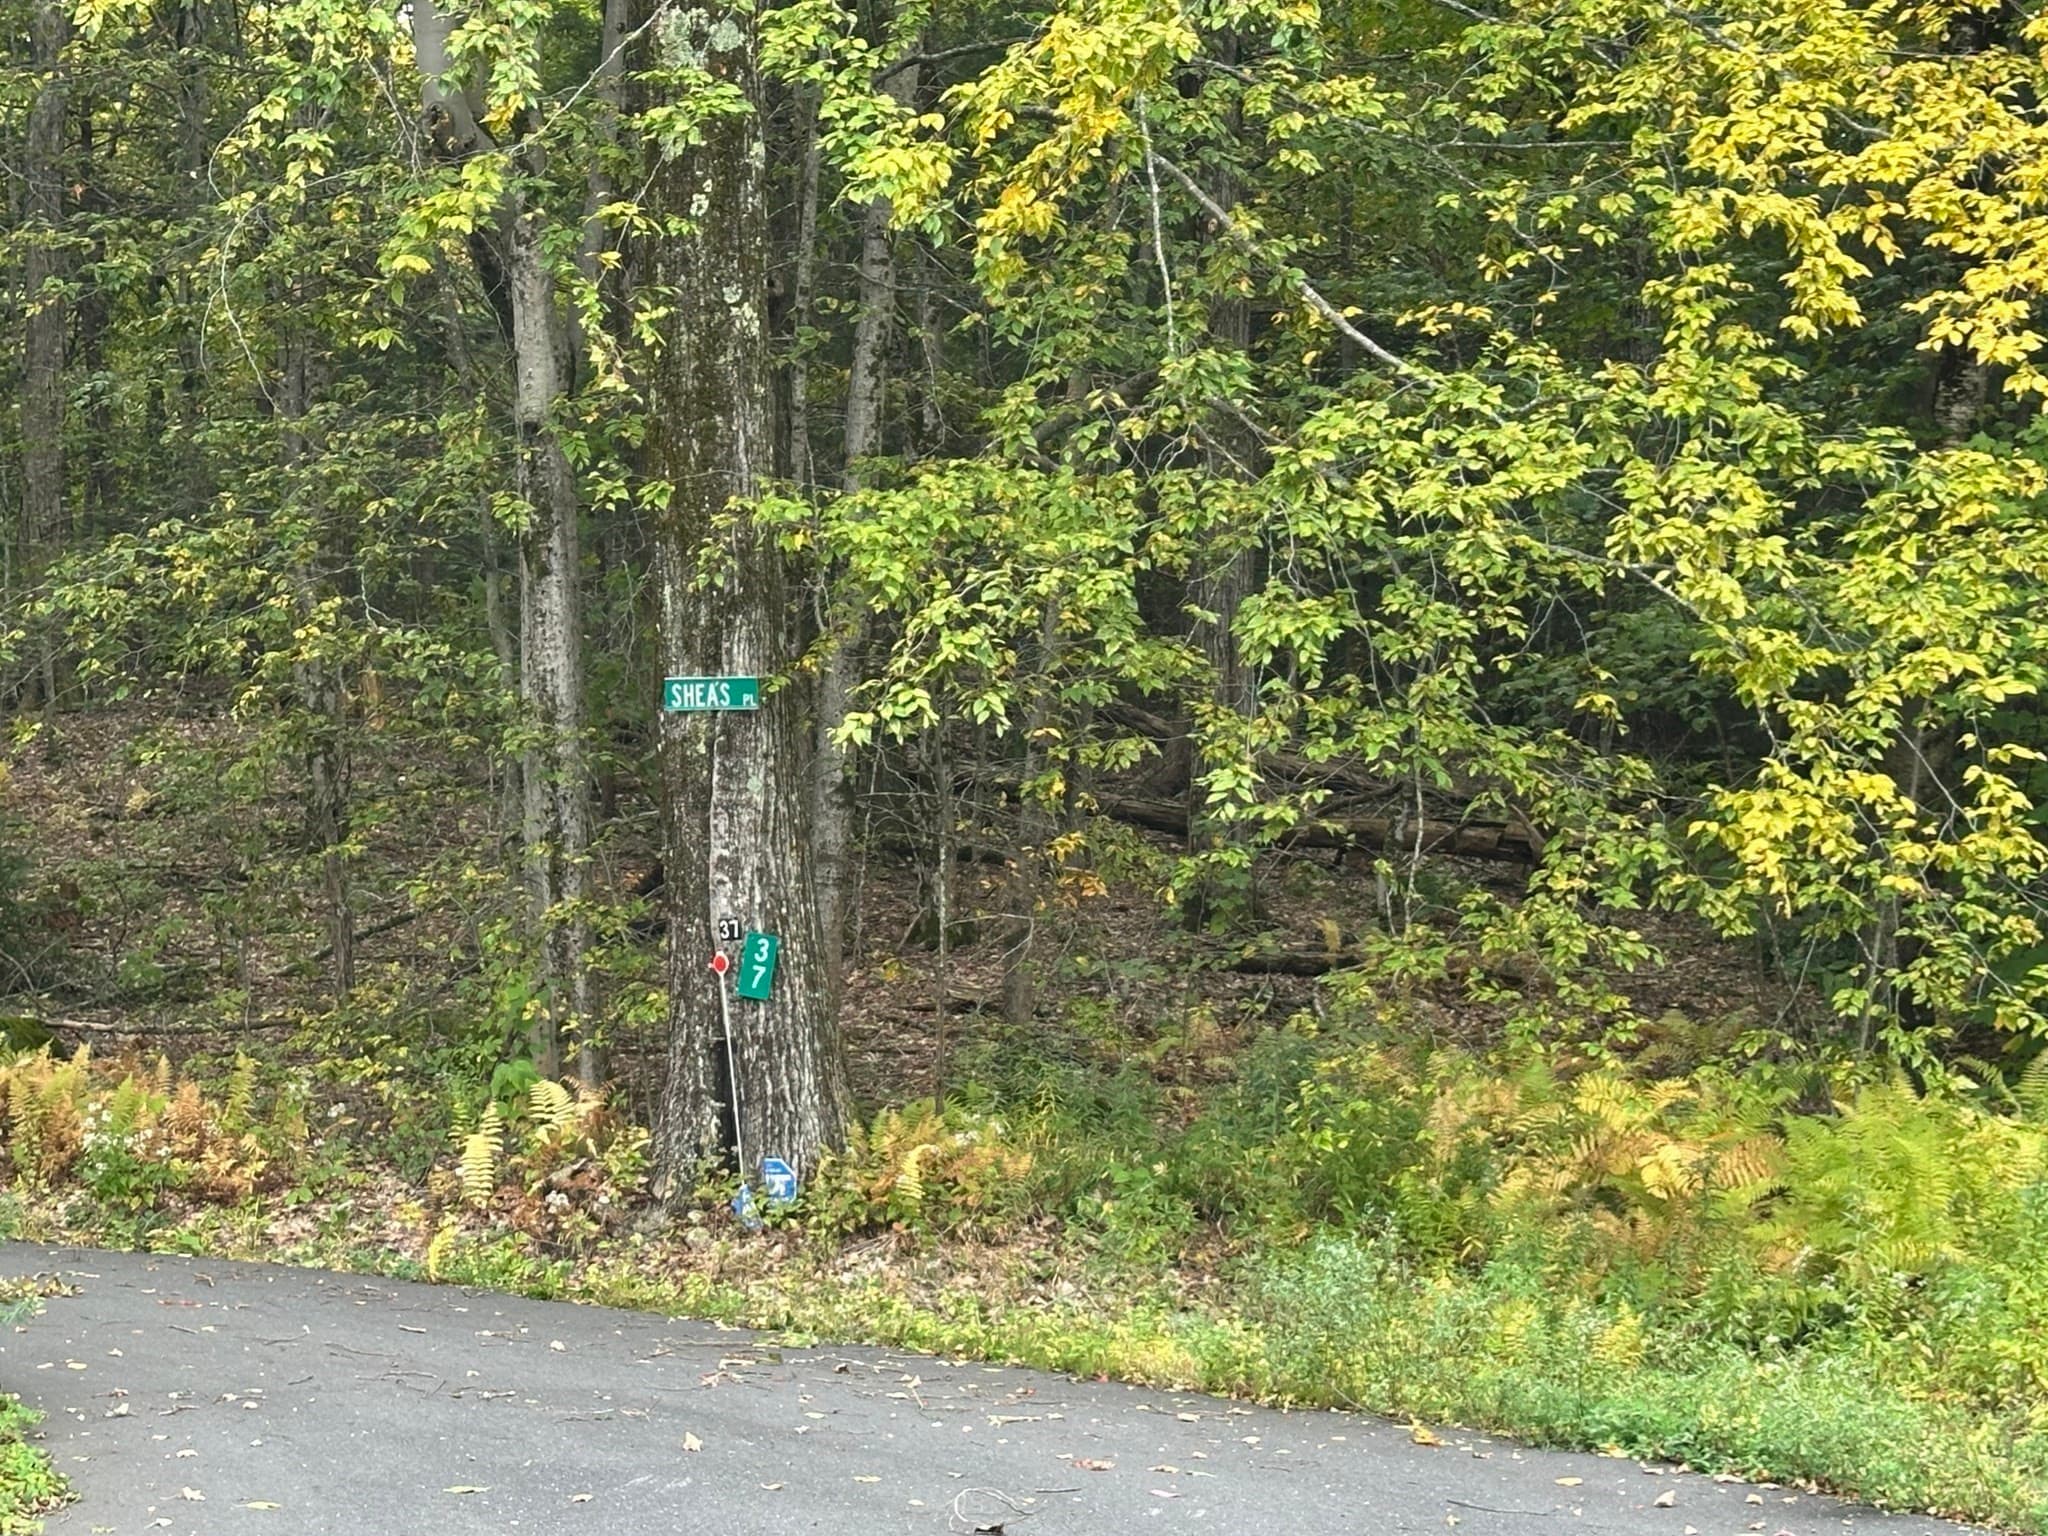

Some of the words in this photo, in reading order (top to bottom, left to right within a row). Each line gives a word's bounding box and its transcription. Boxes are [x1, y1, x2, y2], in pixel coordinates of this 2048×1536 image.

[671, 681, 730, 708] SHEA'S
[742, 694, 757, 707] PL
[720, 920, 738, 939] 37
